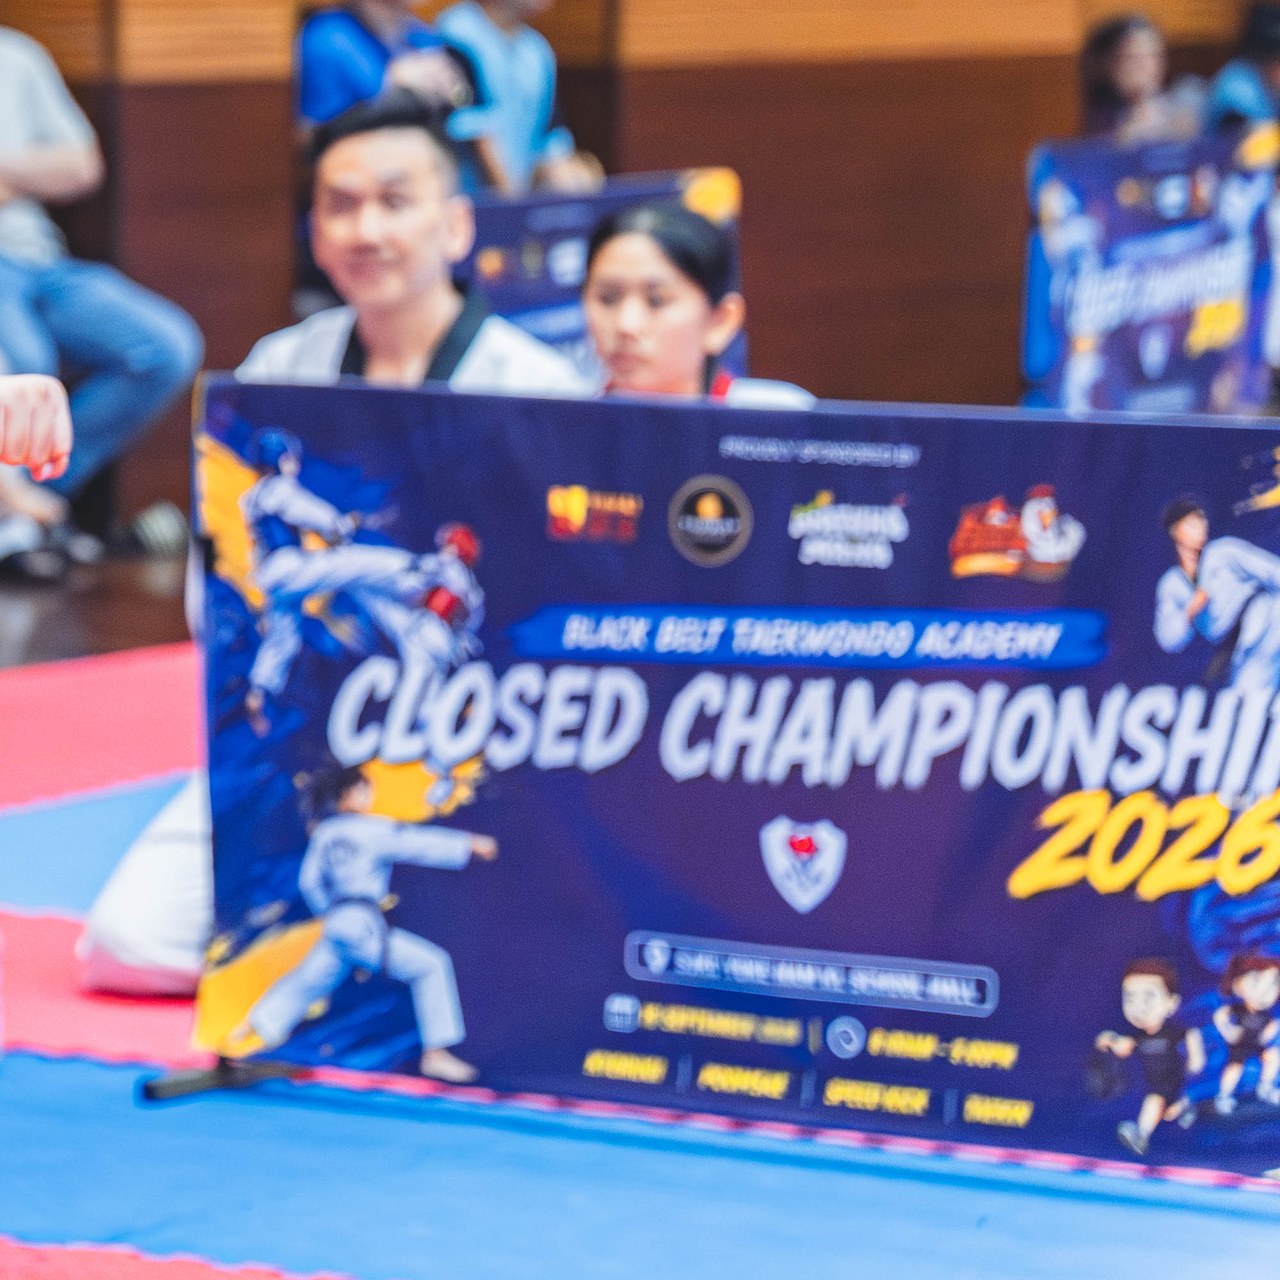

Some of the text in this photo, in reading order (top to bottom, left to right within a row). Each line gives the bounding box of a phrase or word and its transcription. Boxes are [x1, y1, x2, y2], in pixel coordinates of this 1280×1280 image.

[562, 614, 1064, 660] BLACK BELT TAEKWONDO ACADEMY
[327, 655, 649, 773] CLOSED
[1007, 788, 1280, 901] 2026
